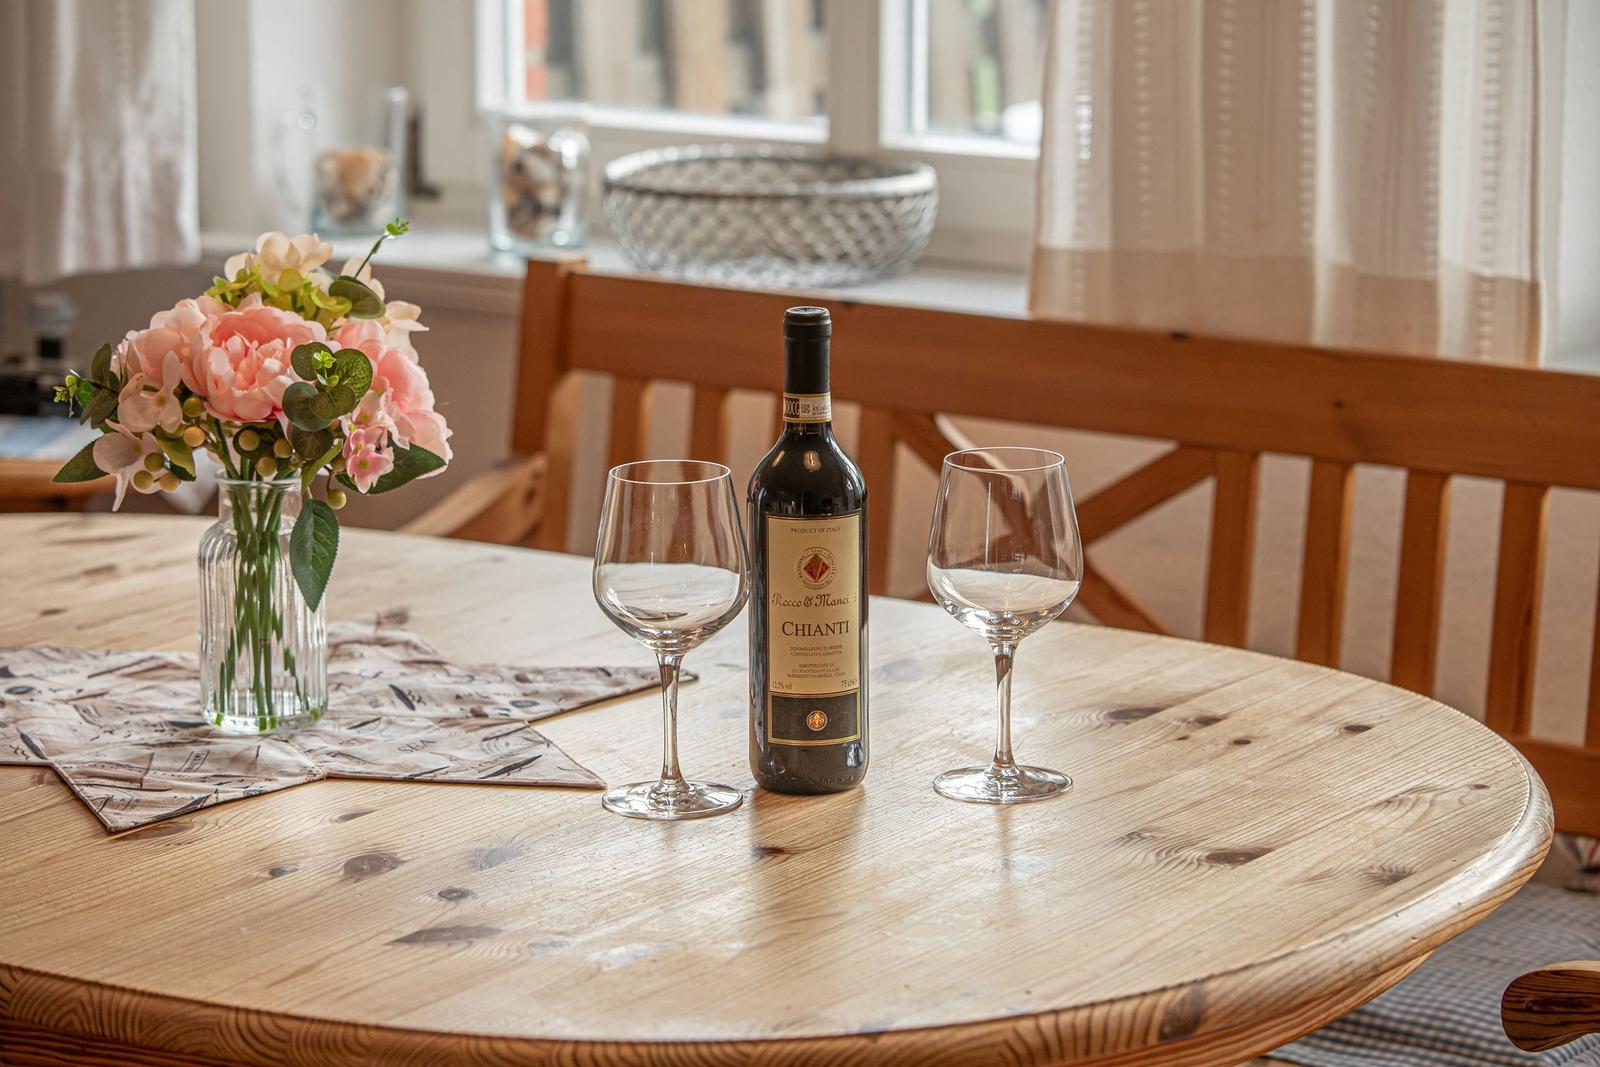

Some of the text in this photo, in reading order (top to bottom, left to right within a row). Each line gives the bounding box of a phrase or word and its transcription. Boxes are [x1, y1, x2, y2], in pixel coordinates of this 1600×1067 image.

[771, 592, 802, 608] Rocco
[803, 596, 813, 608] &
[781, 620, 849, 636] CHIANTI
[397, 739, 437, 753] SEA
